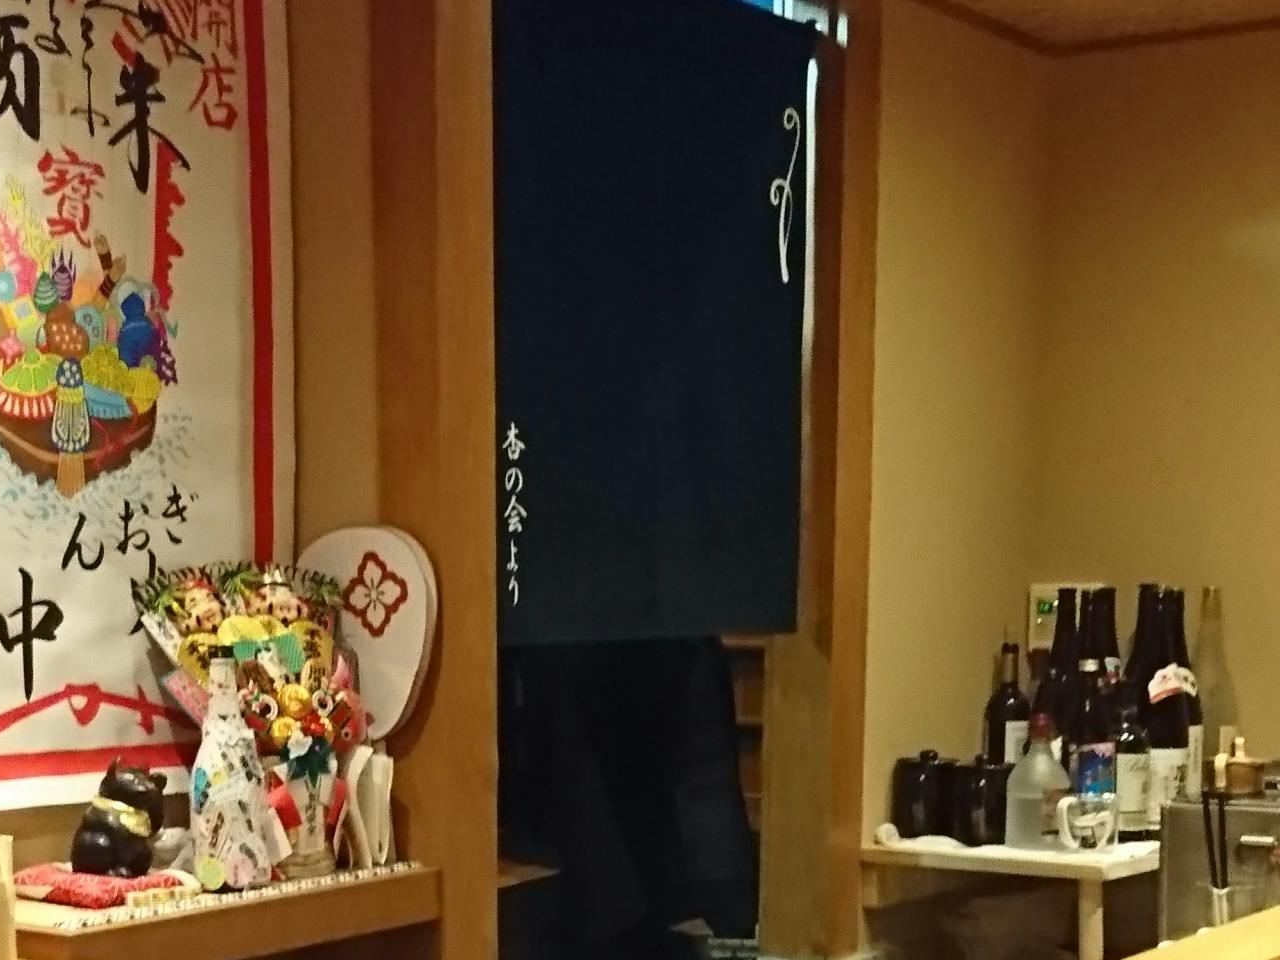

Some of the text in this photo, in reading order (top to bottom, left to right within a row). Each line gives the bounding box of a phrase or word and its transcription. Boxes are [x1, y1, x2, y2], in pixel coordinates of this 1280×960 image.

[502, 421, 528, 607] 杏の会より
